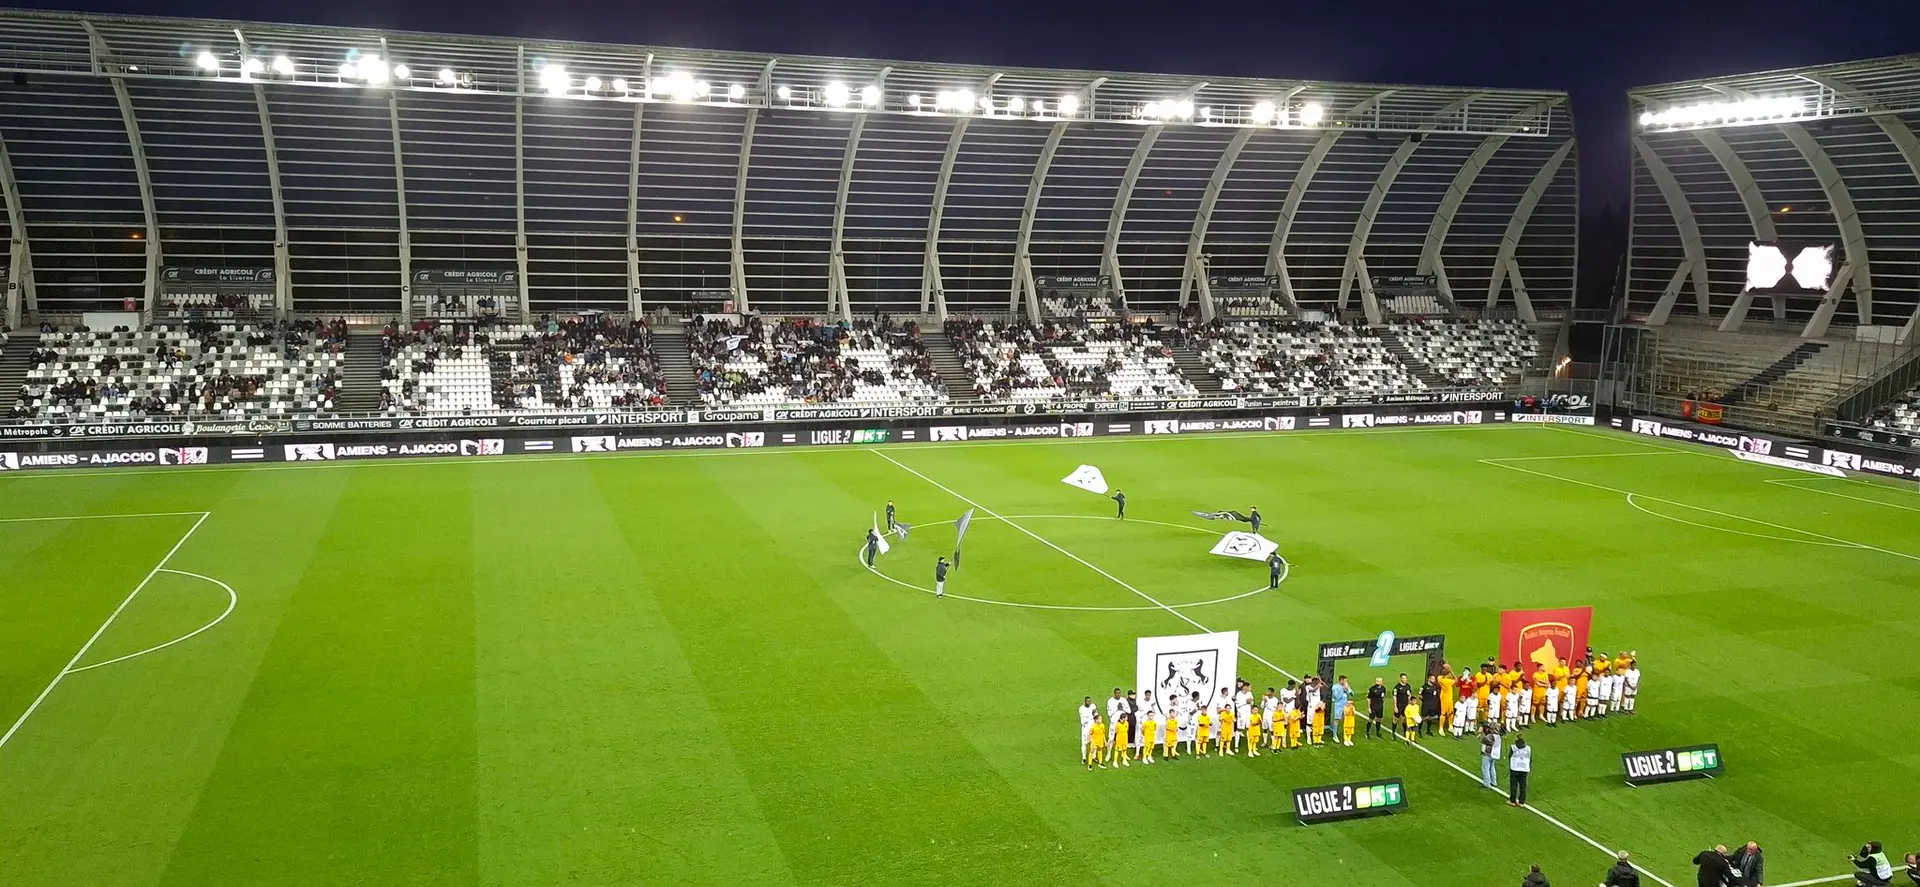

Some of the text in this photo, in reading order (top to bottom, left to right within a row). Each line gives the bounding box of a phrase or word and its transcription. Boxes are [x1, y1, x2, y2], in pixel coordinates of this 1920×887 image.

[1449, 392, 1503, 401] INTERSPORT
[972, 405, 1005, 413] PICARDIE
[1203, 399, 1237, 408] AGRICOLE
[704, 412, 760, 422] Groupama
[790, 409, 817, 418] CRÉDIT
[819, 409, 858, 418] AGRICOLE
[871, 406, 937, 418] INTERSPORT
[416, 418, 448, 427] CRÉDIT
[450, 418, 498, 427] AGRICOLE
[518, 415, 587, 426] Courrier picard
[608, 413, 684, 425] INTERSPORT
[1375, 416, 1408, 424] AMIENS
[1414, 414, 1452, 423] AJACCIO
[1527, 414, 1586, 424] INTERSPORT
[88, 424, 125, 435] CRÉDIT
[127, 424, 180, 434] AGRICOLE
[196, 423, 246, 434] Boulangerie
[313, 420, 392, 430] SOMME BATTERIES
[1180, 421, 1214, 430] AMIENS
[1222, 420, 1263, 429] AJACCIO
[4, 427, 48, 437] Métropole
[811, 429, 887, 444] LIGUE 2 KT
[968, 427, 1007, 438] AMIENS
[1015, 426, 1059, 436] AJACCIO
[1661, 427, 1692, 439] AMIENS
[1698, 432, 1738, 446] AJACCIO
[618, 436, 663, 448] AMIENS
[672, 435, 724, 447] AJACCIO
[337, 445, 388, 456] AMIENS
[399, 443, 458, 454] AJACCIO
[21, 454, 78, 466] AMIENS
[90, 452, 156, 464] AJACCIO
[1861, 458, 1904, 474] AMIENS
[1371, 631, 1395, 666] 2
[1400, 641, 1419, 652] LIGUE
[1323, 647, 1343, 658] LIGUE
[1625, 750, 1718, 778] LIGUE 2 KT
[1297, 783, 1400, 816] LIGUE 2 KT
